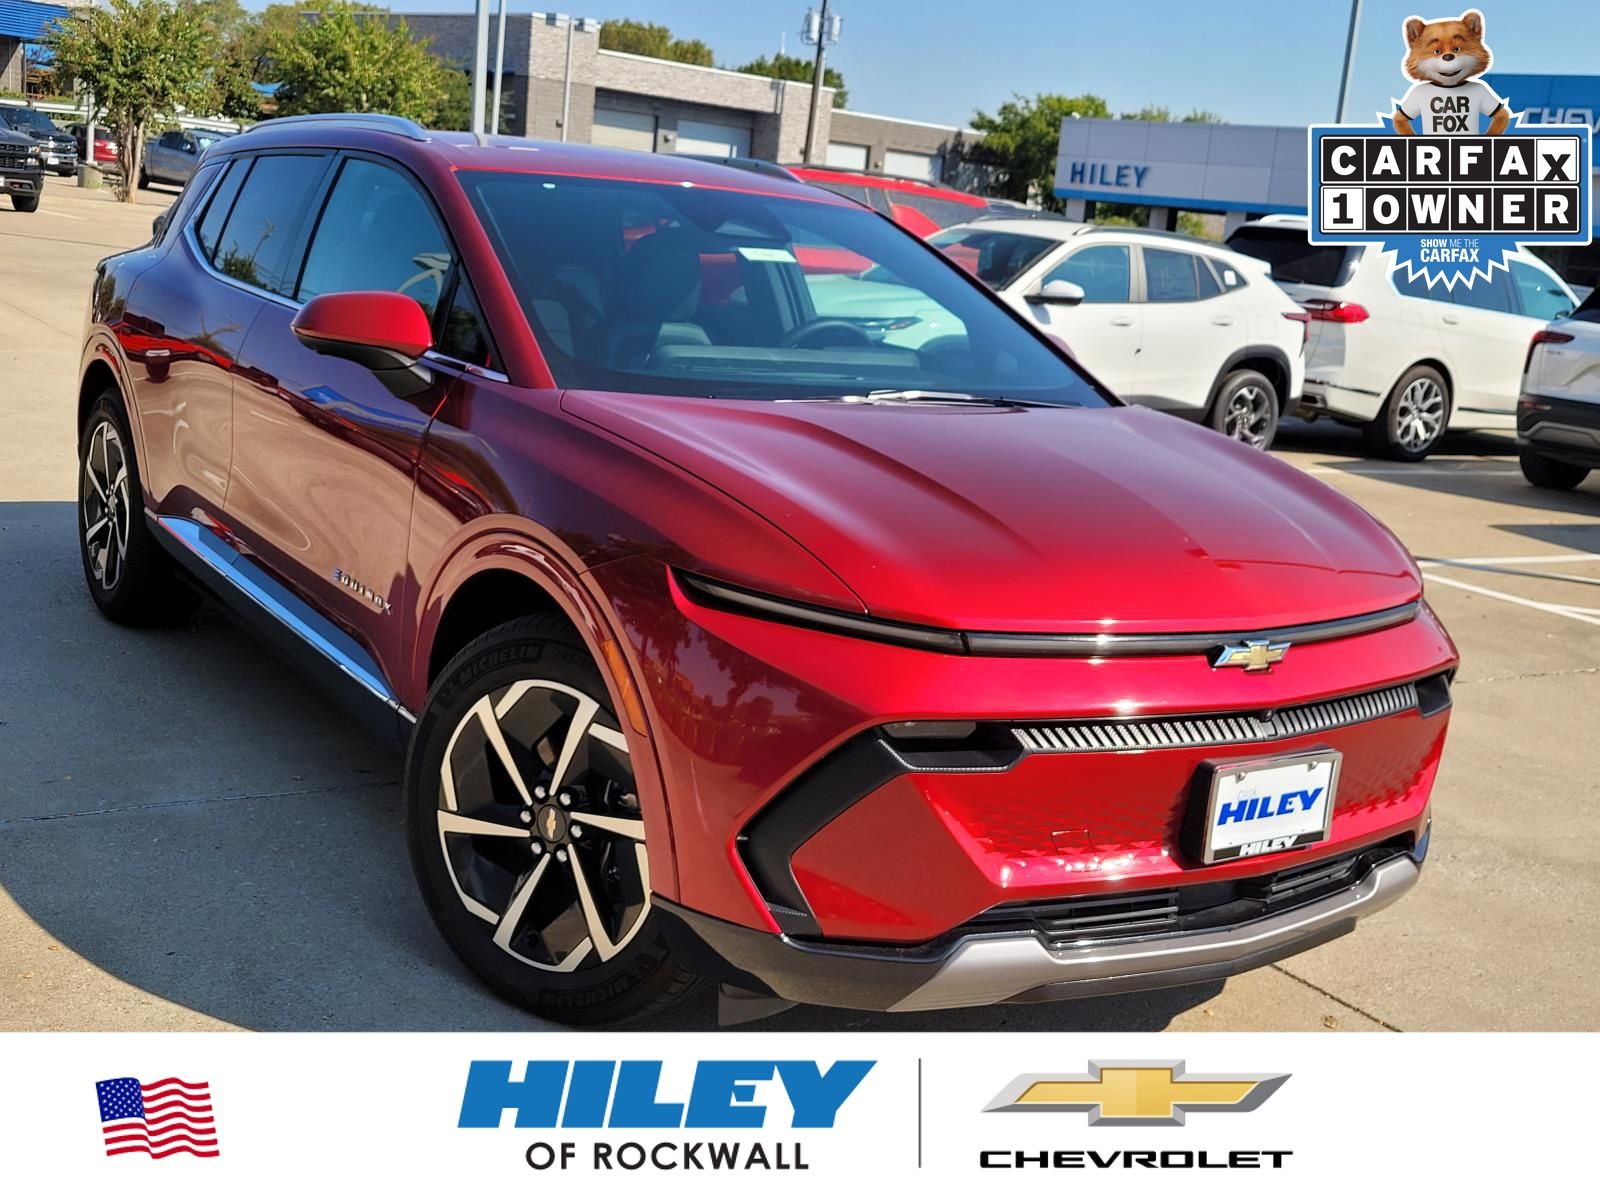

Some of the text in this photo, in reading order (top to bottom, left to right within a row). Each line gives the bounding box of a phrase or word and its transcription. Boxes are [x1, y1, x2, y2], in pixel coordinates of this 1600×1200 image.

[1070, 162, 1150, 188] HILEY
[459, 644, 539, 686] MICHELIN
[1217, 787, 1324, 826] HILEY
[1239, 836, 1298, 857] HILEY
